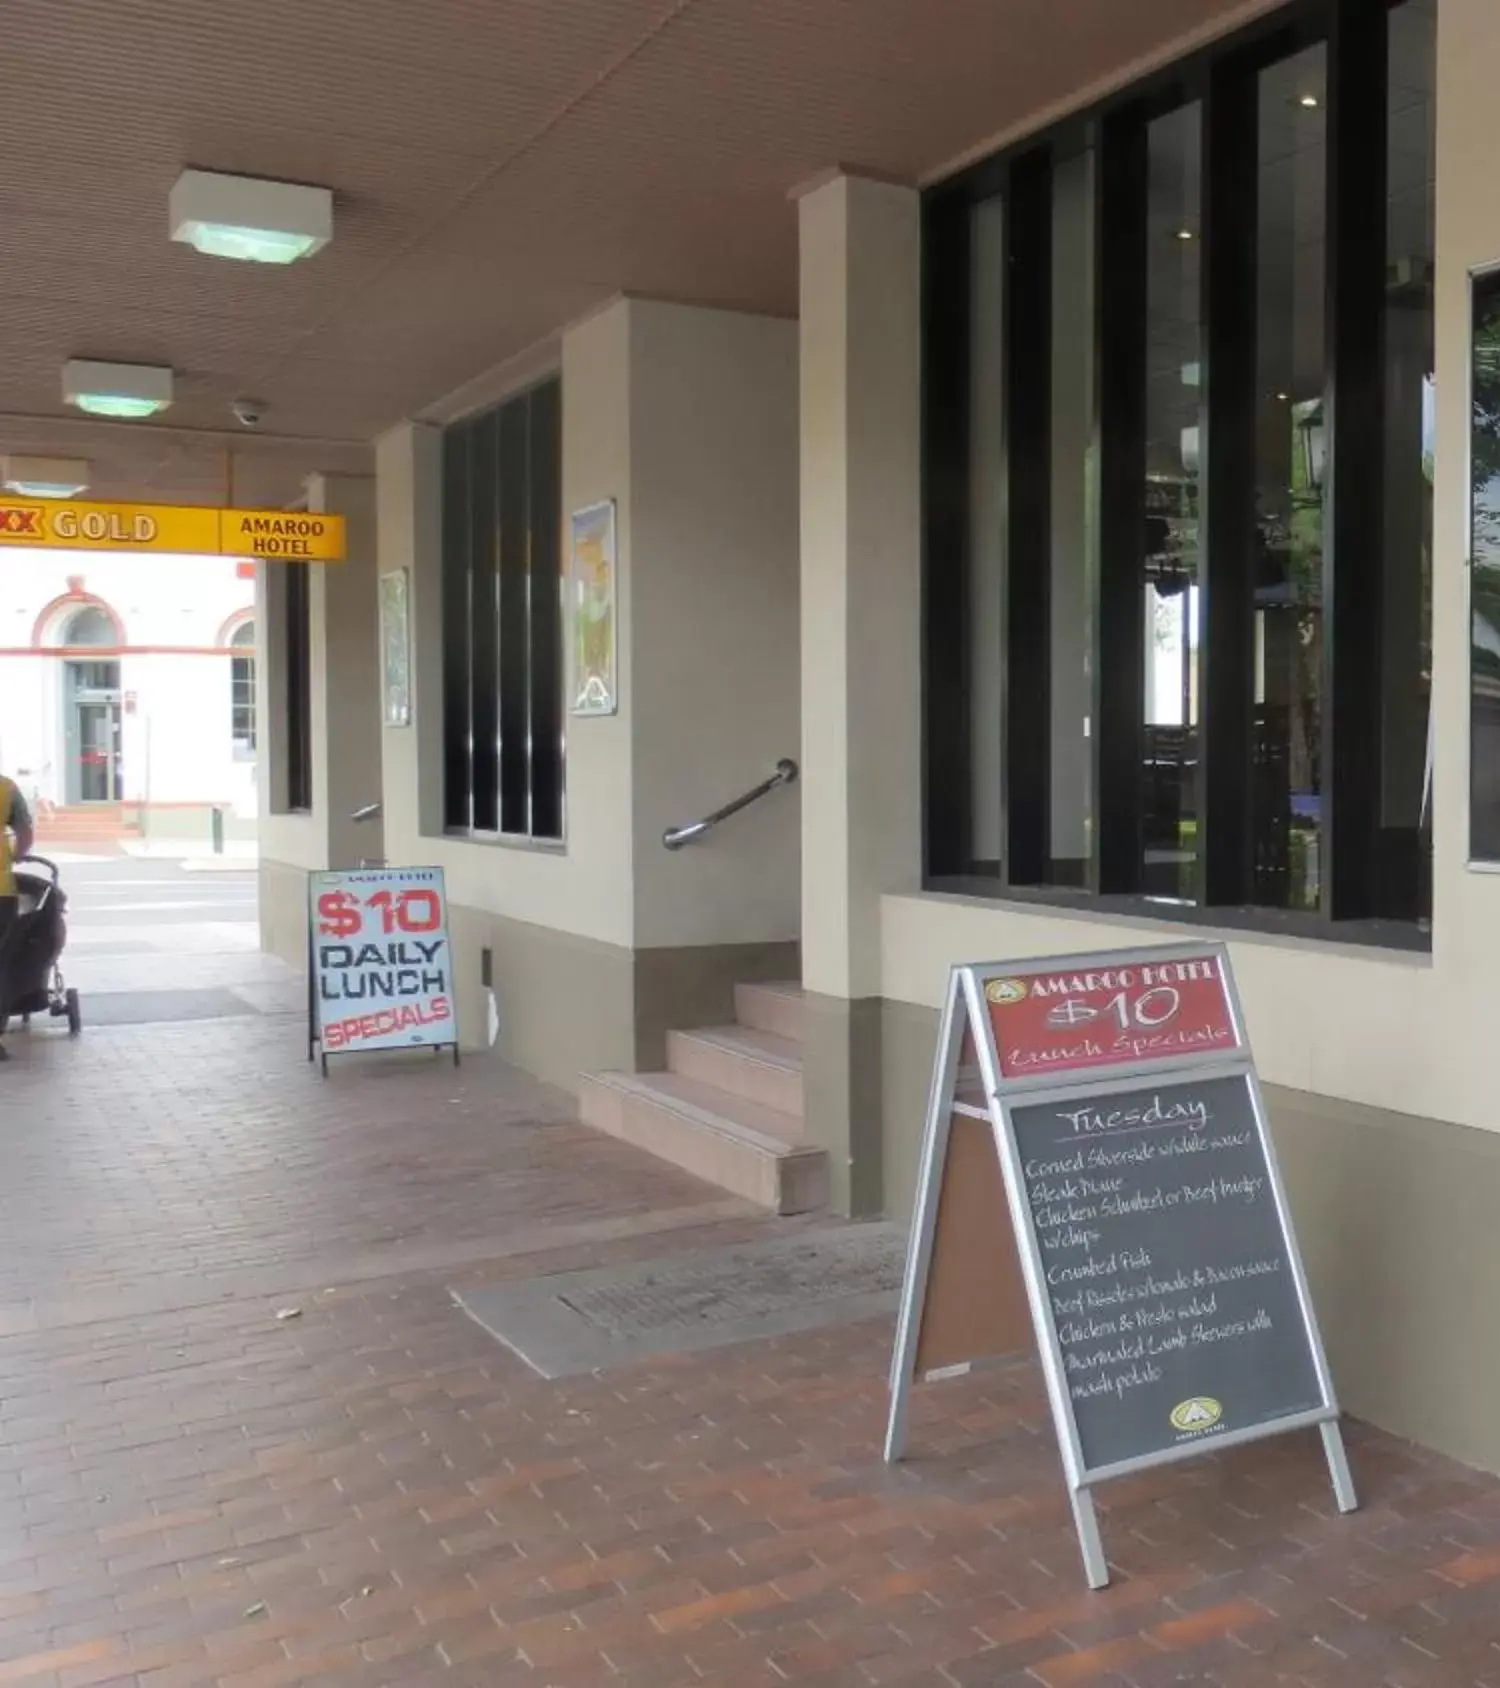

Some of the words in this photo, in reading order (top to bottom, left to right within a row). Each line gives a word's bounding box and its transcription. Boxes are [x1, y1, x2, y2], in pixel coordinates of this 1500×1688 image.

[53, 509, 157, 542] GOLD
[240, 517, 325, 537] AMAROO
[253, 537, 314, 555] HOTEL
[318, 888, 441, 939] $10
[320, 940, 445, 968] DAILY
[321, 969, 445, 1000] LUNCH
[1029, 971, 1136, 998] AMAROO
[1140, 960, 1216, 985] HOTEL
[322, 996, 450, 1047] SPECIALS
[1047, 986, 1180, 1030] $10
[1008, 1038, 1103, 1067] Lunch
[1112, 1024, 1229, 1056] Specials
[1056, 1095, 1212, 1132] Tuesday
[1025, 1149, 1085, 1179] Corned
[1031, 1179, 1079, 1205] Steak
[1035, 1203, 1097, 1228] Chicken
[1165, 1189, 1182, 1205] or
[1182, 1177, 1218, 1204] Beef
[1048, 1252, 1118, 1285] Crumbed
[1060, 1319, 1117, 1345] Chicken
[1119, 1313, 1135, 1332] &
